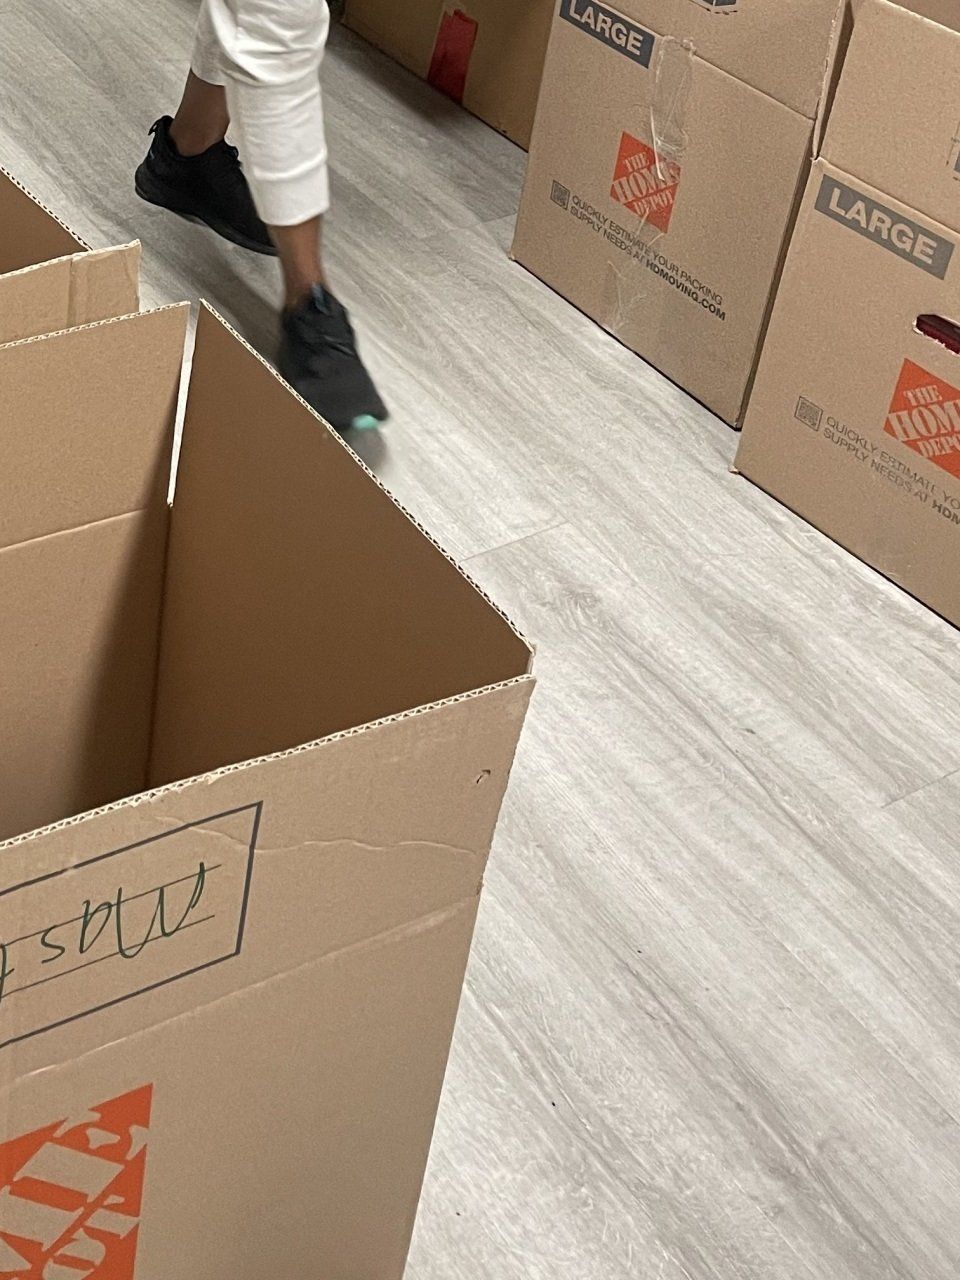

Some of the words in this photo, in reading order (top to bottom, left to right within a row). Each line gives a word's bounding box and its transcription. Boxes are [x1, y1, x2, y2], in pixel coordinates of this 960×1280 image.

[624, 151, 649, 173] THE
[572, 195, 608, 225] QUICKLY
[609, 220, 651, 257] ESTIMATE
[653, 251, 679, 276] YOUR
[680, 270, 723, 306] PACKING
[828, 187, 938, 265] LARGE
[570, 206, 602, 233] SUPPLY
[603, 229, 633, 257] NEEDS
[645, 259, 726, 321] HDMOVING.COM
[887, 399, 960, 442] HOM
[902, 384, 943, 407] THE
[823, 428, 869, 463] SUPPLY
[871, 459, 913, 493] NEEDS
[826, 416, 878, 454] QUICKLY
